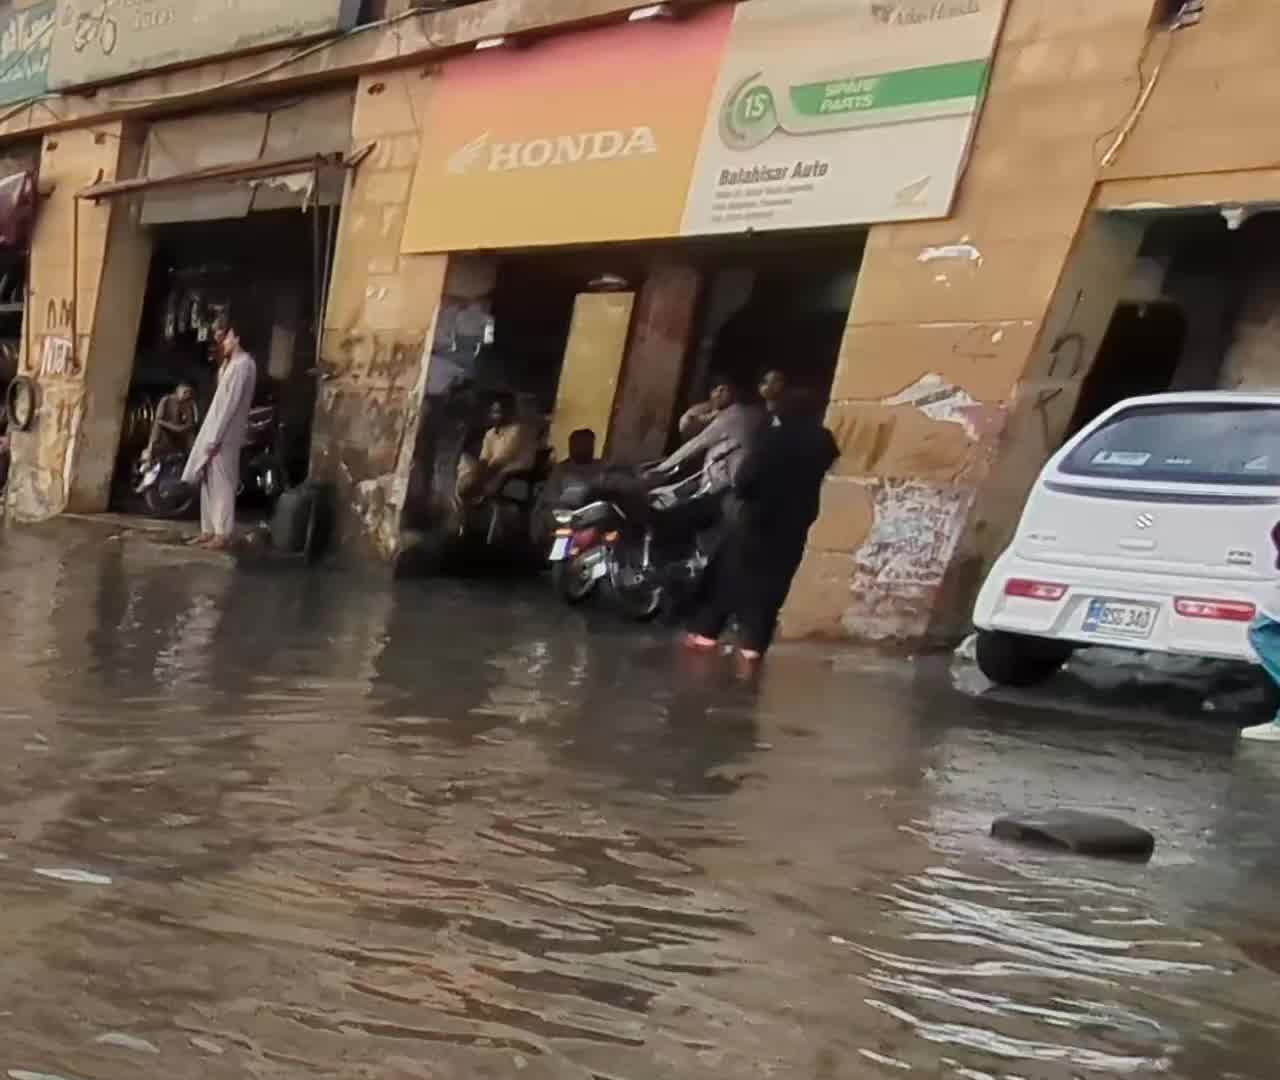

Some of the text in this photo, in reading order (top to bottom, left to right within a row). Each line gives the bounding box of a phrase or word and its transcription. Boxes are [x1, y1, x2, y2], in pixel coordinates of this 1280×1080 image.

[824, 80, 873, 98] SPARE
[820, 95, 873, 113] PARTS
[487, 125, 657, 172] HONDA
[719, 159, 829, 186] Balahisar Auto
